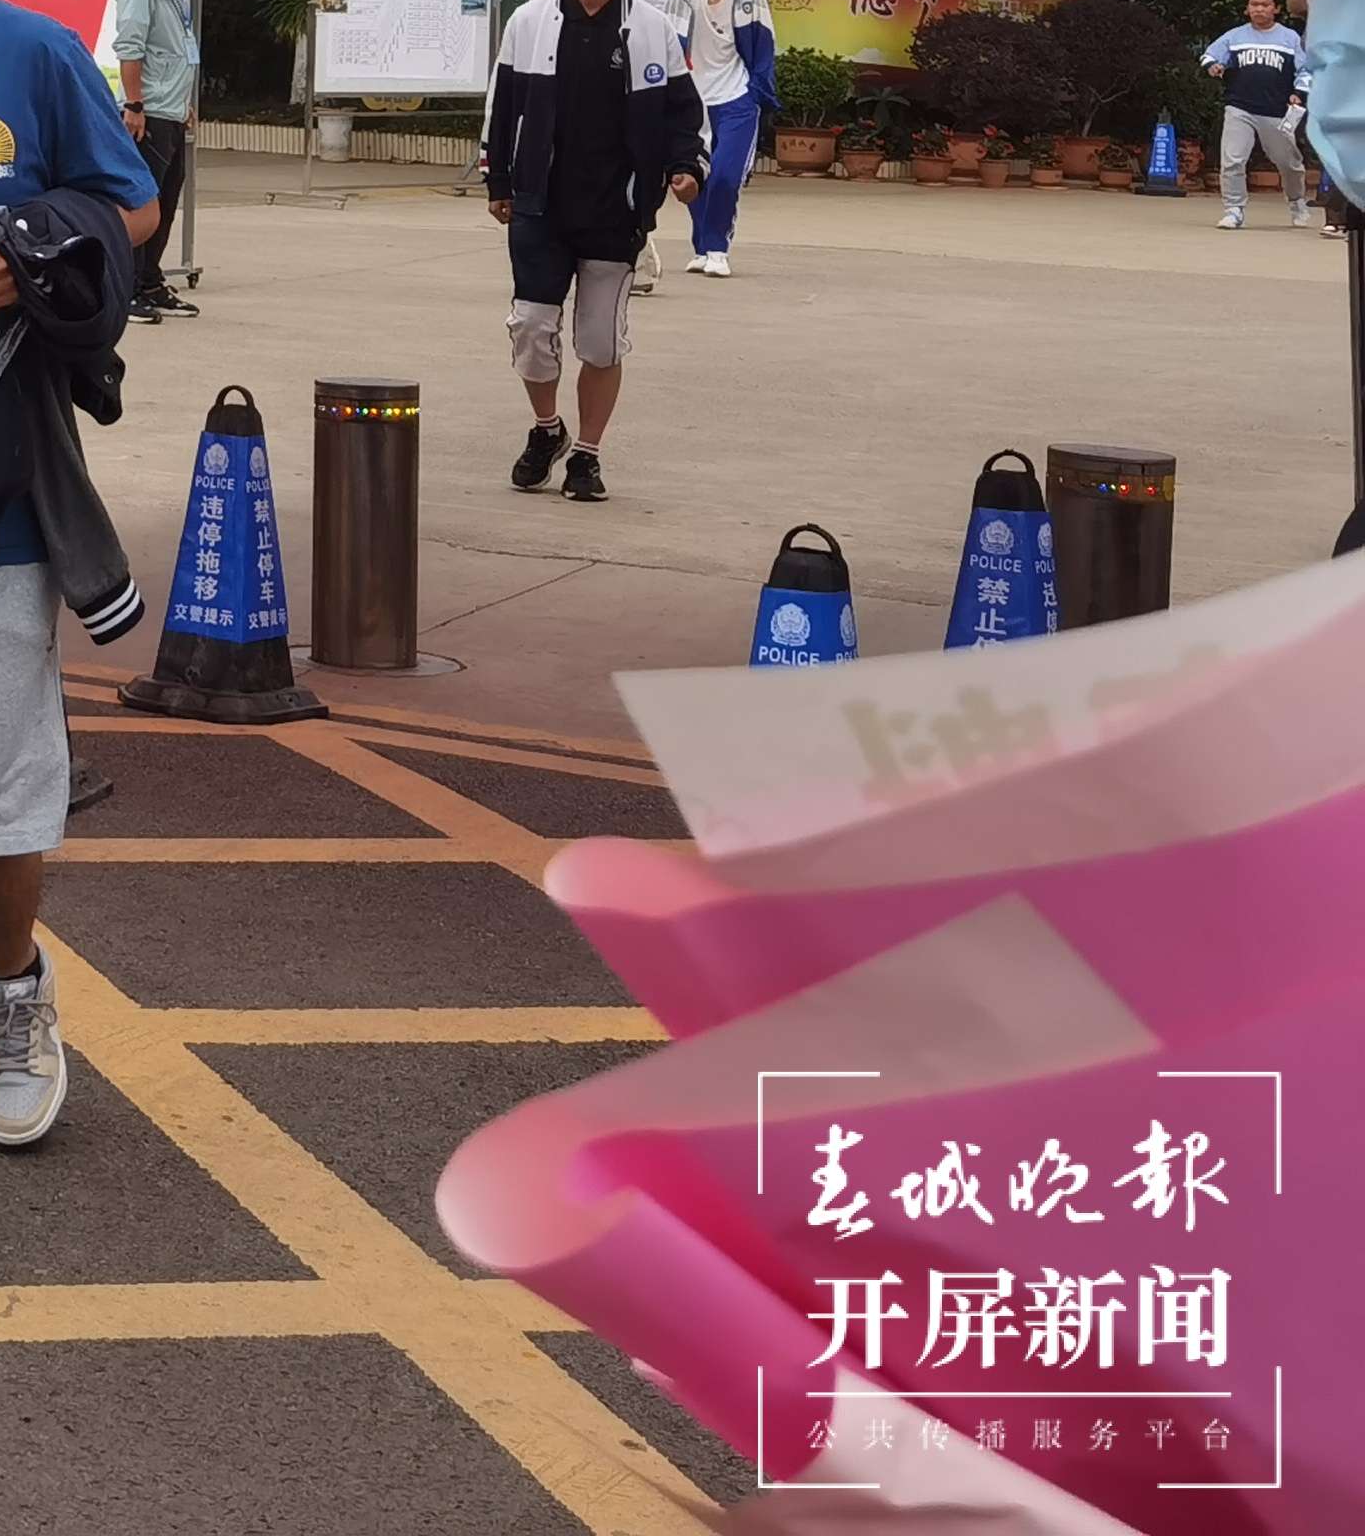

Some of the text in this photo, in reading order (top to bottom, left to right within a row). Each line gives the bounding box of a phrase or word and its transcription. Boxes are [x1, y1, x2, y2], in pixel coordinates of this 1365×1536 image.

[1237, 47, 1285, 72] MOVING
[195, 475, 235, 492] POLICE
[193, 495, 225, 602] 违停拖移
[253, 498, 275, 606] 禁止停车
[969, 554, 1022, 574] POLICE
[174, 602, 234, 627] 交警提示
[758, 645, 821, 667] POLICE
